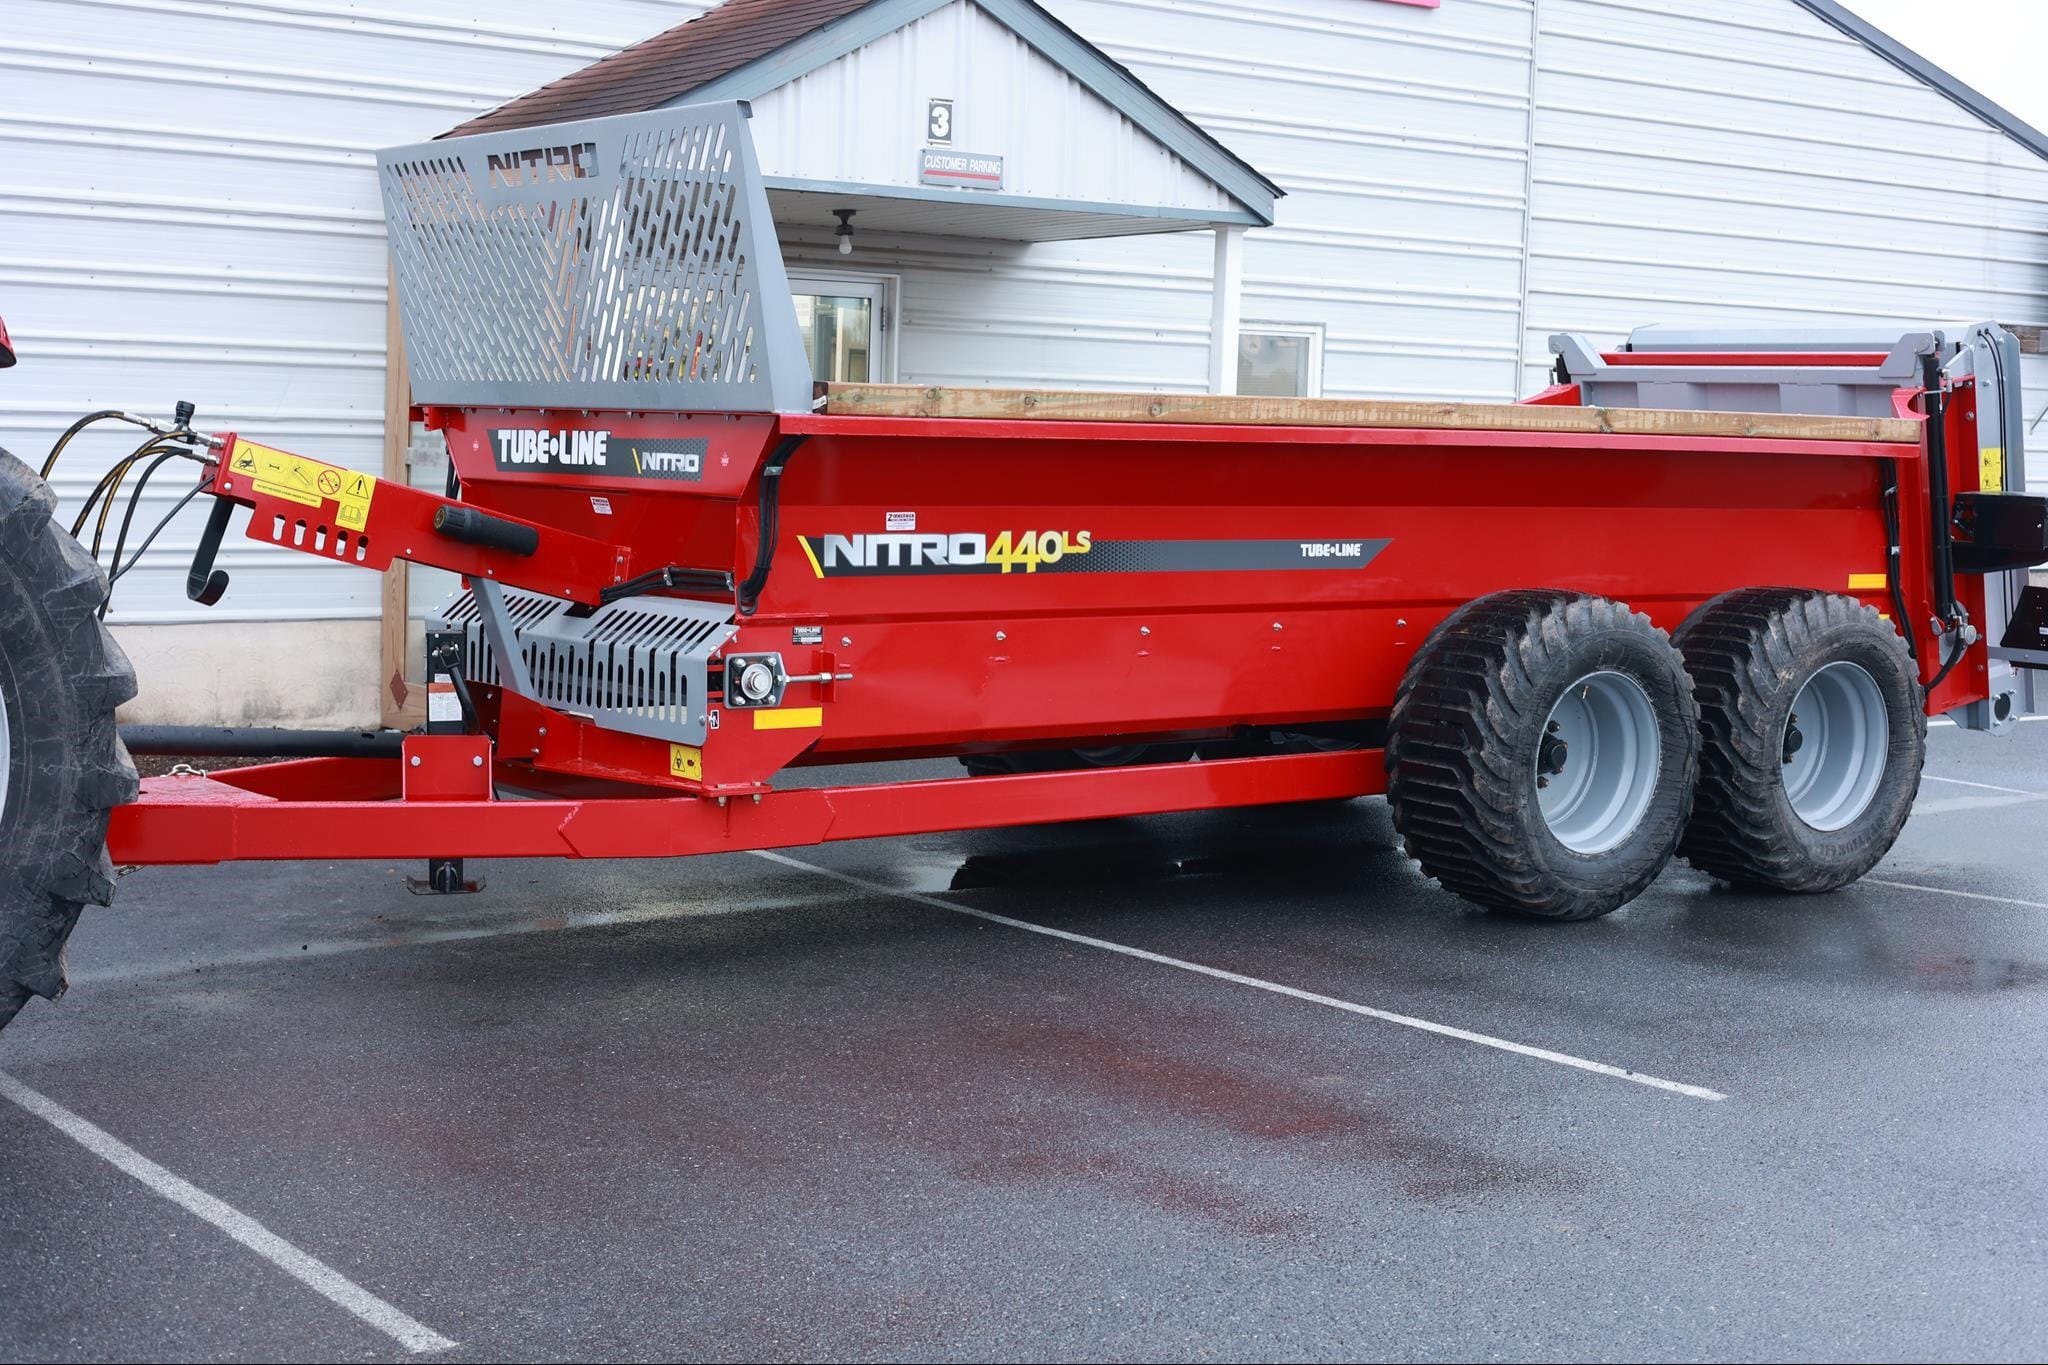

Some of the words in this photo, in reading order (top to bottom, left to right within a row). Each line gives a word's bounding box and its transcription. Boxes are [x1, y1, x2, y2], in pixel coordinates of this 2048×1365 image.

[931, 106, 950, 137] 3
[487, 142, 599, 189] NITRO
[924, 155, 968, 171] CUSTOMER
[969, 159, 1001, 175] PARKING
[641, 451, 700, 473] NITRO
[823, 533, 986, 568] NITRO
